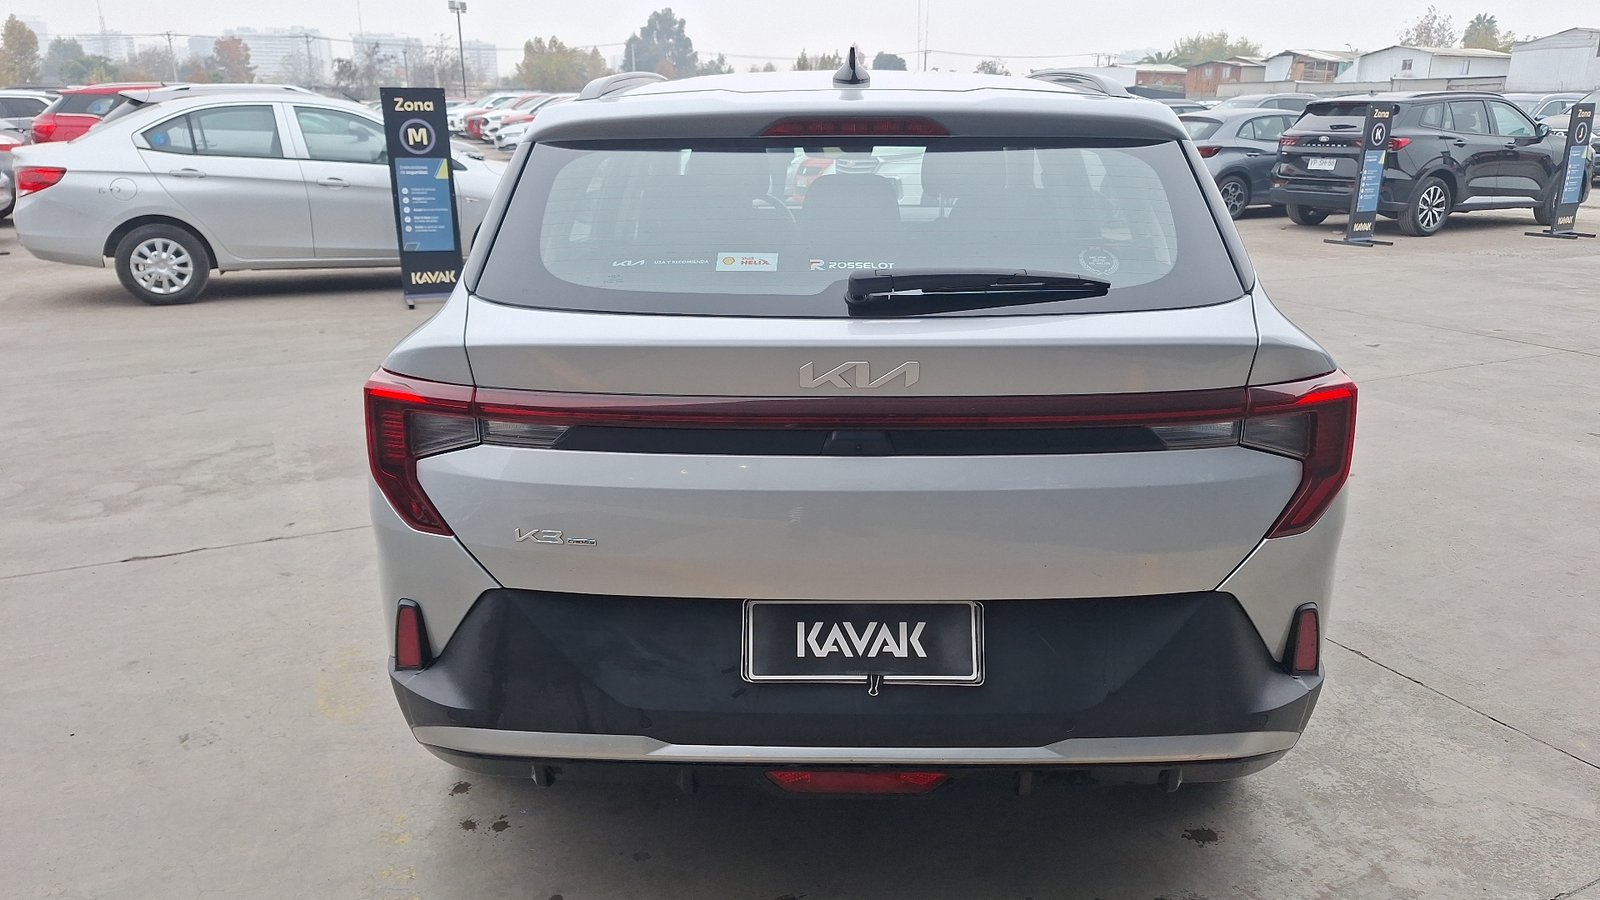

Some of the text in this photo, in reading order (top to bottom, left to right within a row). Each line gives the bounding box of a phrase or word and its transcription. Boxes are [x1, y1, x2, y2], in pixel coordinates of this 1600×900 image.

[394, 97, 434, 112] Zona
[1374, 108, 1389, 118] Zona
[1578, 109, 1591, 118] Zona
[407, 127, 428, 146] M
[1375, 128, 1382, 140] K
[1578, 127, 1584, 138] J
[411, 270, 457, 285] KAVAK
[799, 360, 921, 389] KIA
[514, 527, 565, 545] K3
[796, 621, 928, 658] KAVAK
